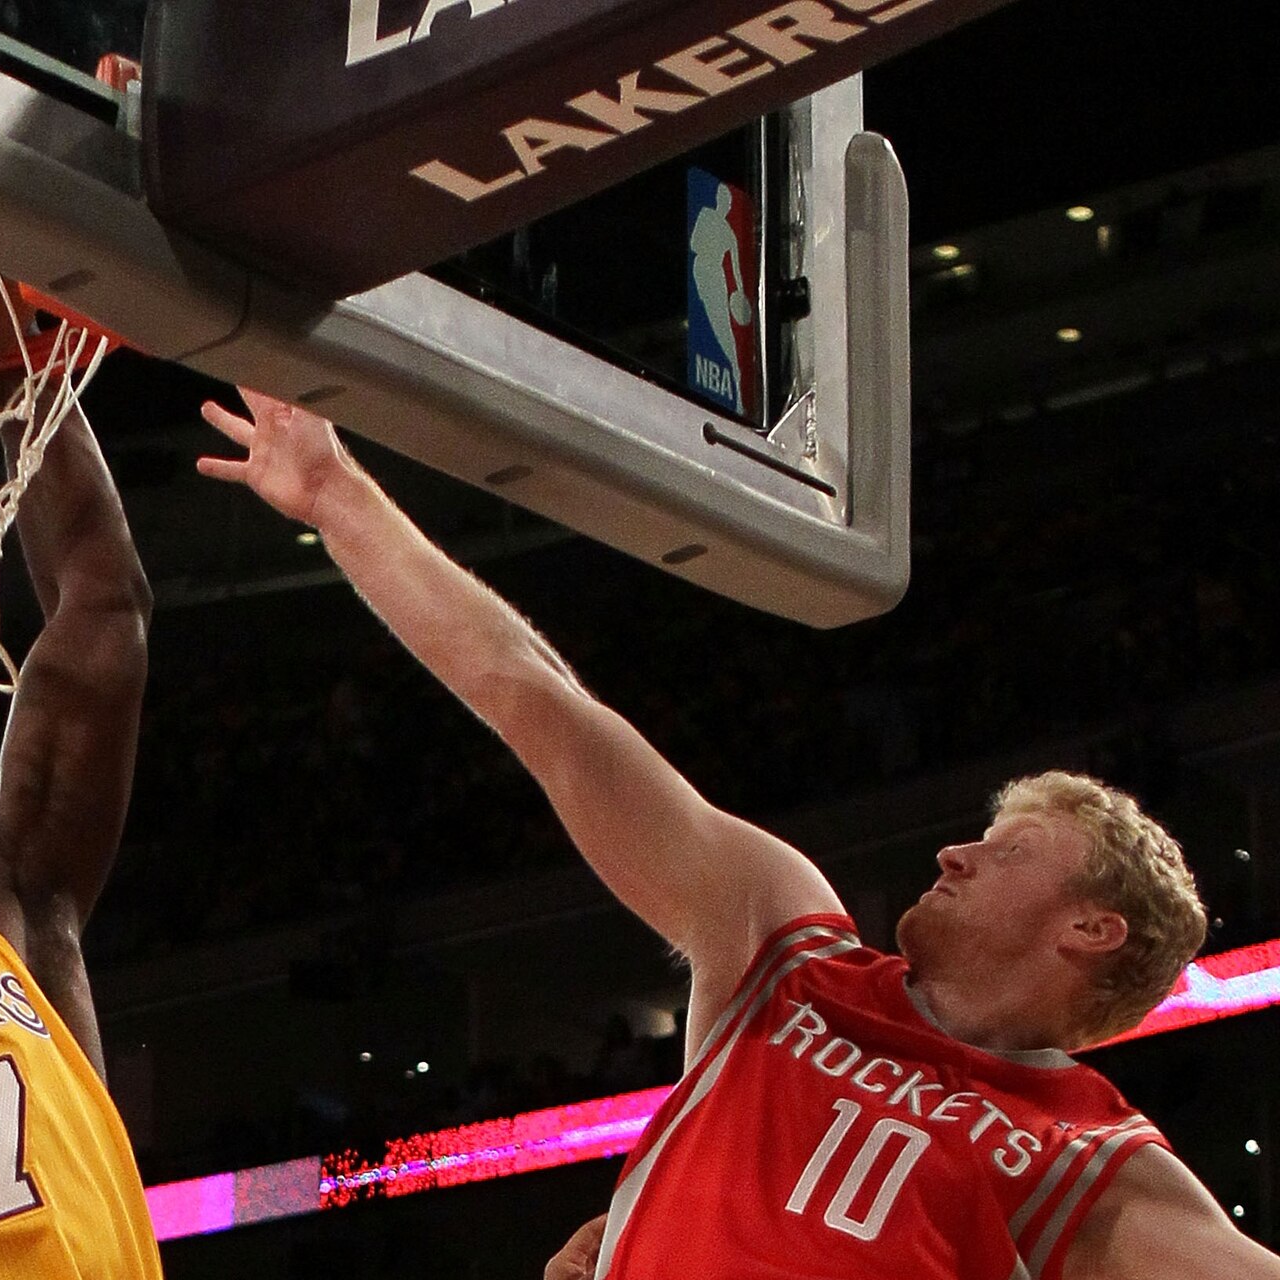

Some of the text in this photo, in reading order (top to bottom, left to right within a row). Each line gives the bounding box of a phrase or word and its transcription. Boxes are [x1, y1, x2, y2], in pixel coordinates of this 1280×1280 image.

[695, 353, 733, 400] NBA
[770, 999, 1042, 1177] ROCKETS
[784, 1098, 932, 1240] 10
